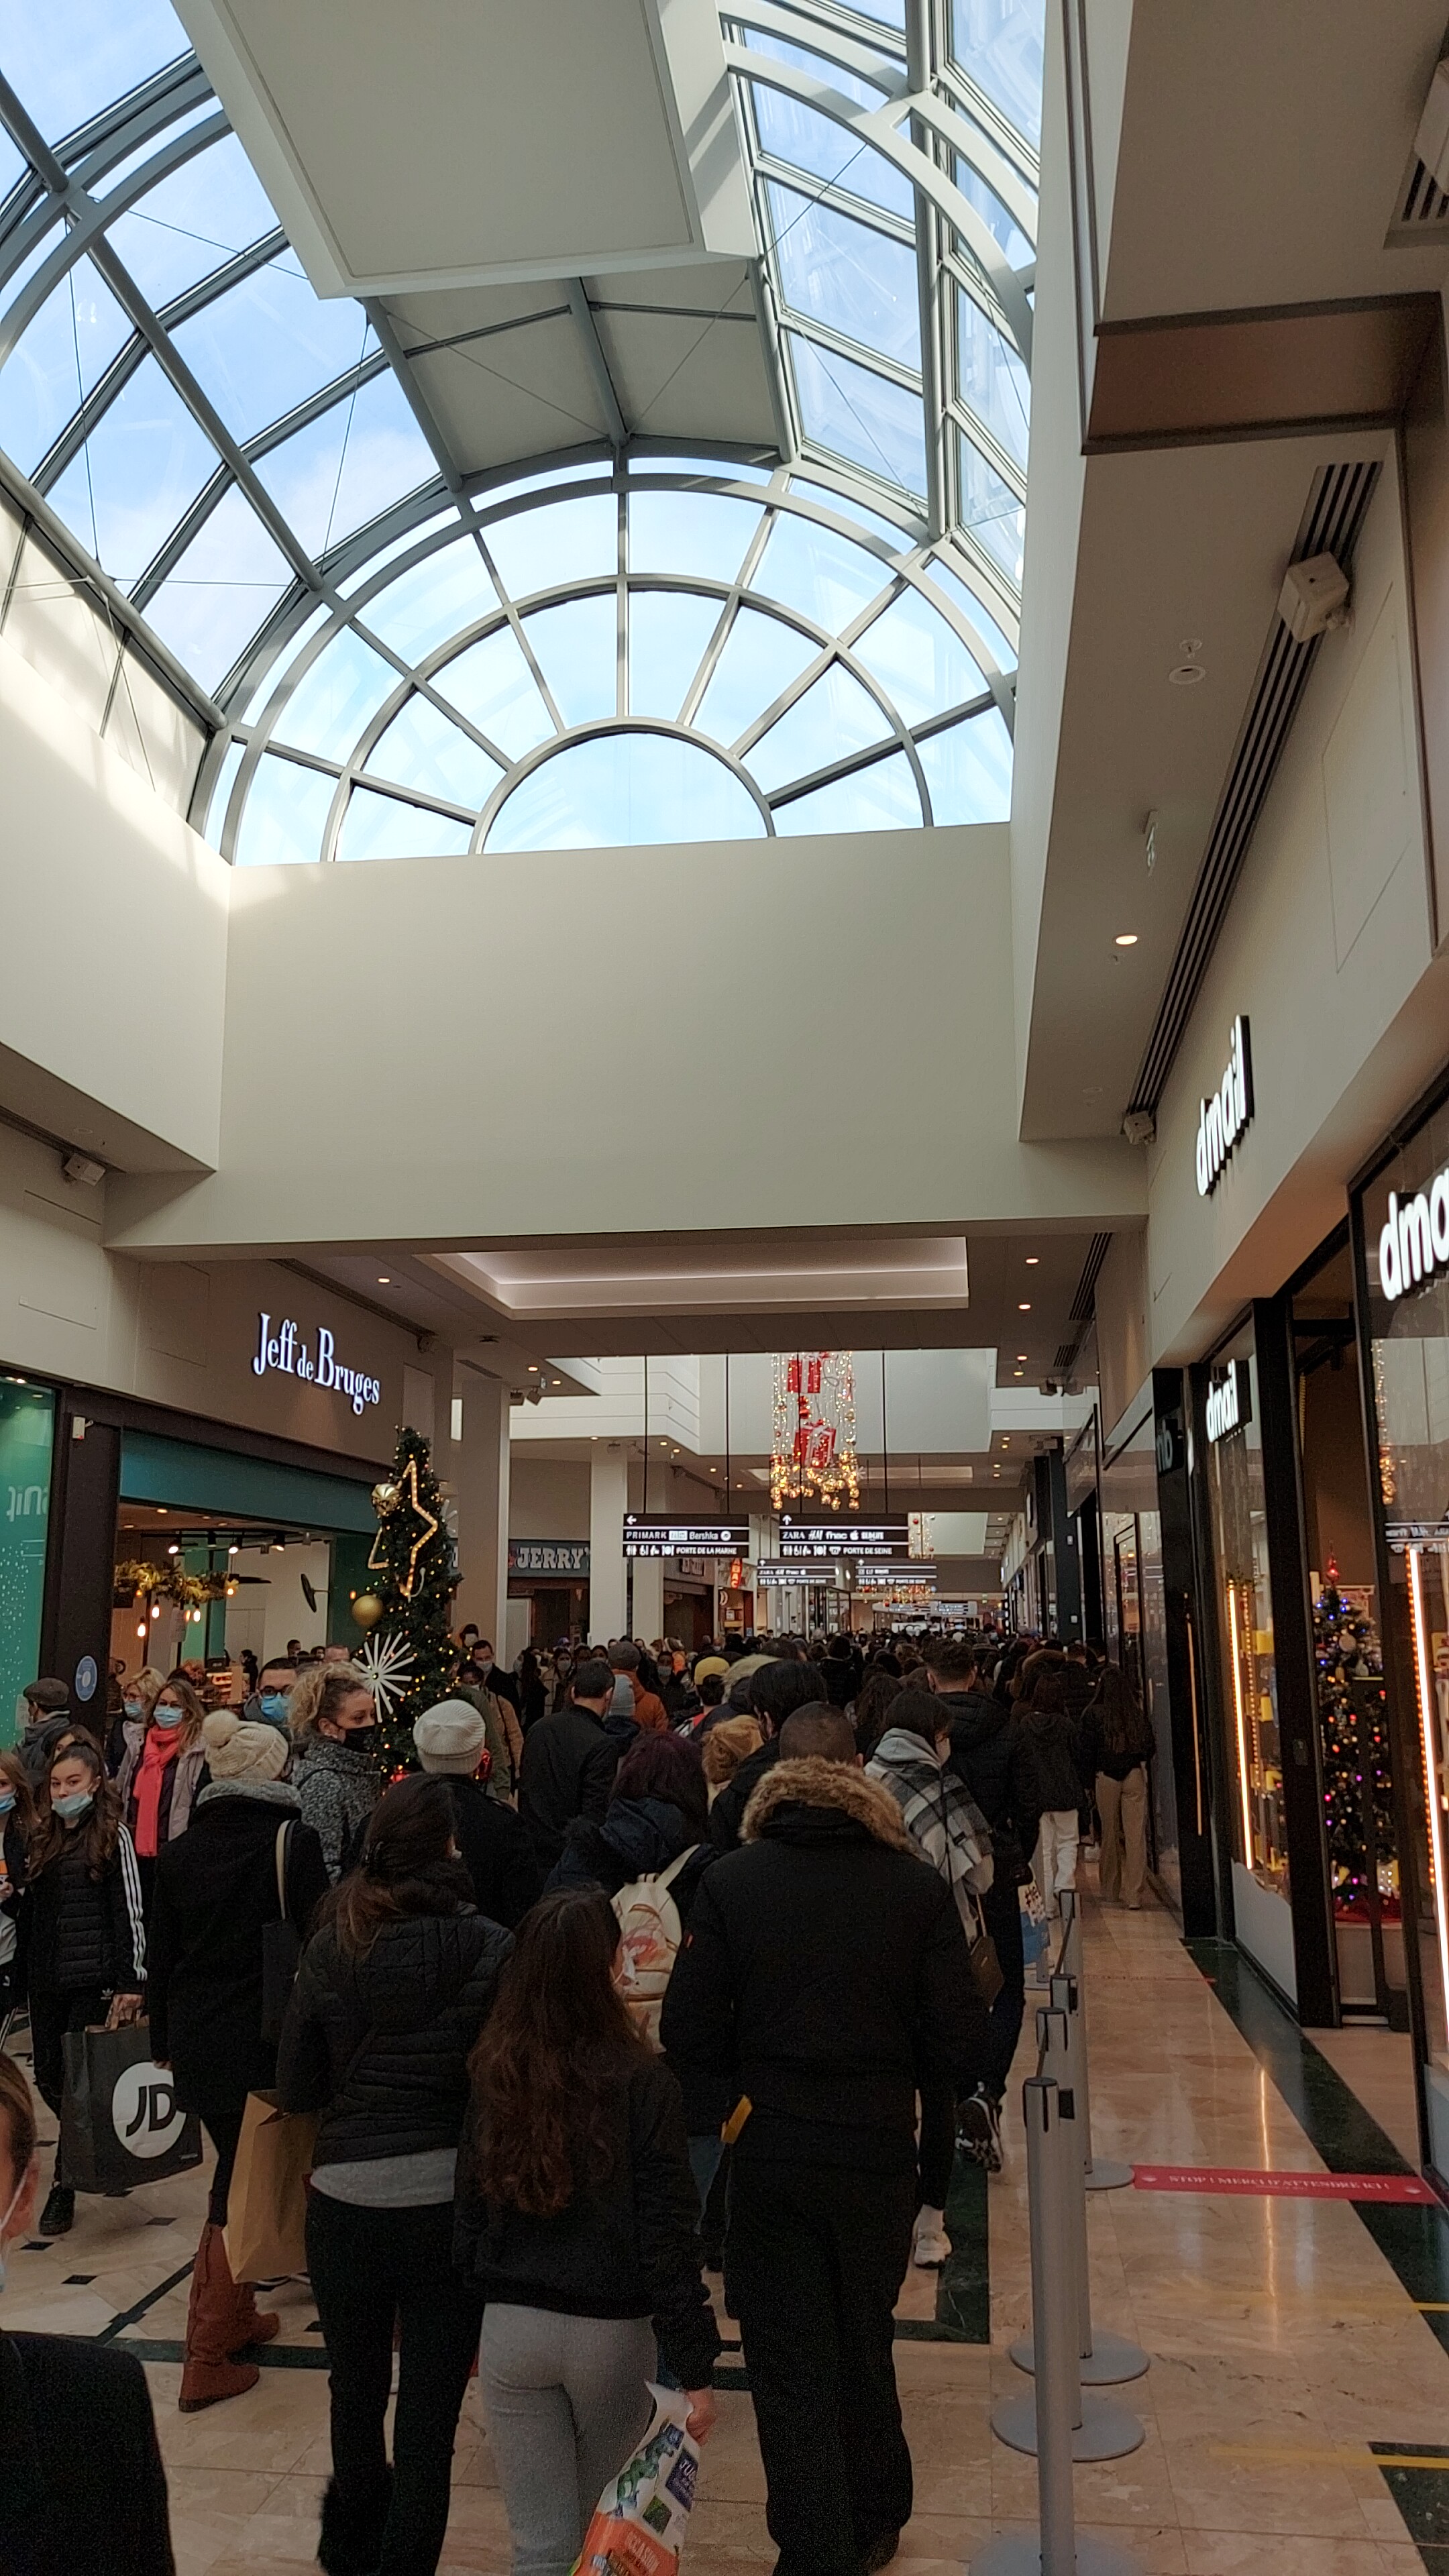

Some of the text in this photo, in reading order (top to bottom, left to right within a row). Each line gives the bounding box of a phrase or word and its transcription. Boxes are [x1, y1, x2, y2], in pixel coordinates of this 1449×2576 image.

[1195, 1015, 1247, 1196] dmail
[1379, 1167, 1449, 1301] dma
[254, 1313, 380, 1415] Jeff de Bruges
[1207, 1358, 1238, 1443] dmail
[689, 1532, 718, 1540] Bershka
[782, 1532, 805, 1540] ZARA
[826, 1531, 847, 1540] fnac
[517, 1547, 590, 1569] JERRY'
[730, 1558, 741, 1588] ABAC
[126, 2083, 177, 2137] JD
[1169, 2175, 1206, 2183] STOP
[1218, 2177, 1265, 2186] MERCI
